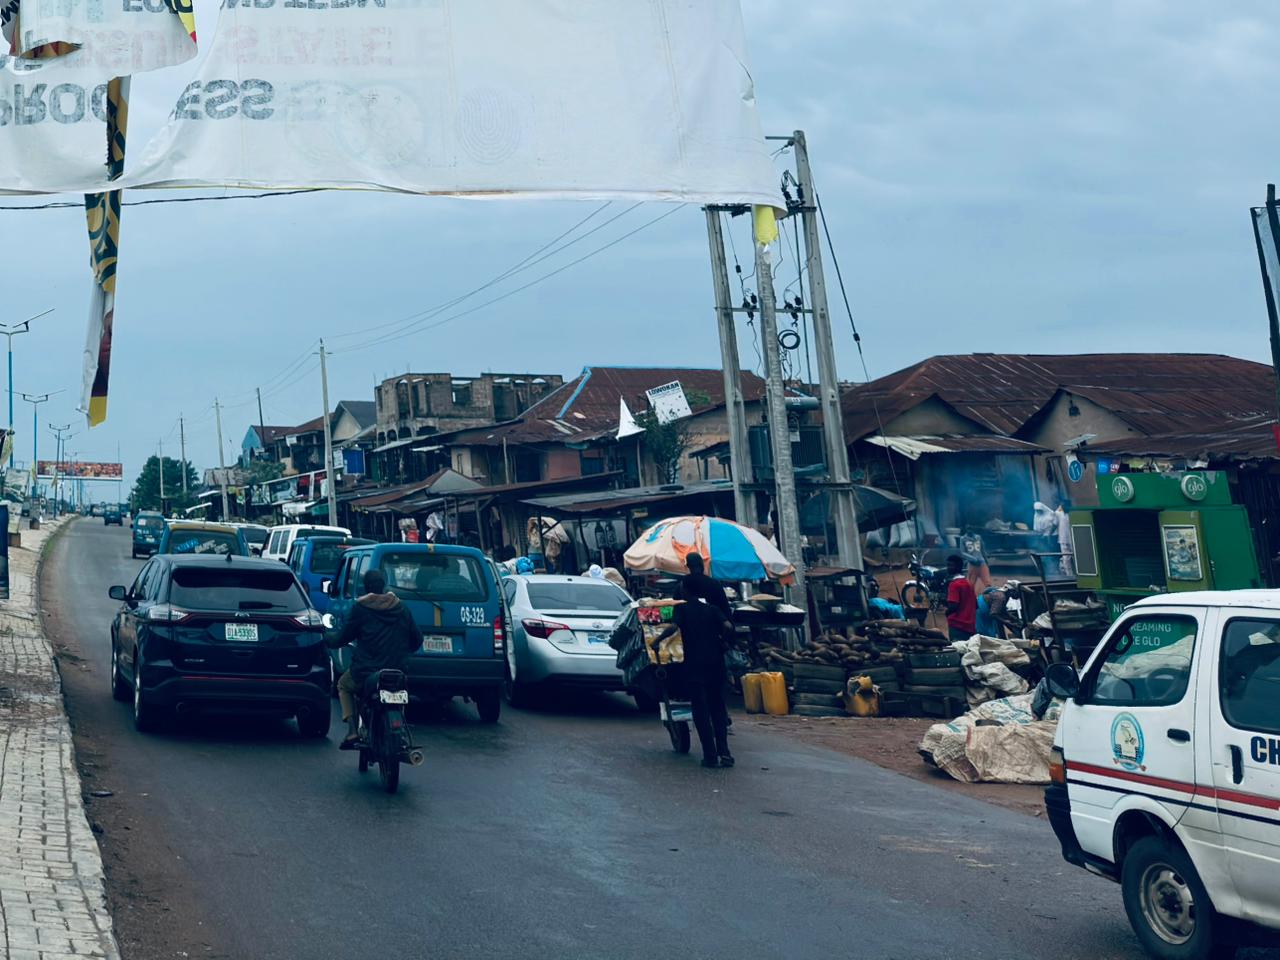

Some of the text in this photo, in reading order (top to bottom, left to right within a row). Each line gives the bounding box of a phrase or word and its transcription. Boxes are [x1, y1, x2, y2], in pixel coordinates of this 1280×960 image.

[1114, 483, 1128, 496] glo
[1188, 481, 1204, 496] glo
[1142, 636, 1160, 646] GLO
[1250, 735, 1280, 766] CH
